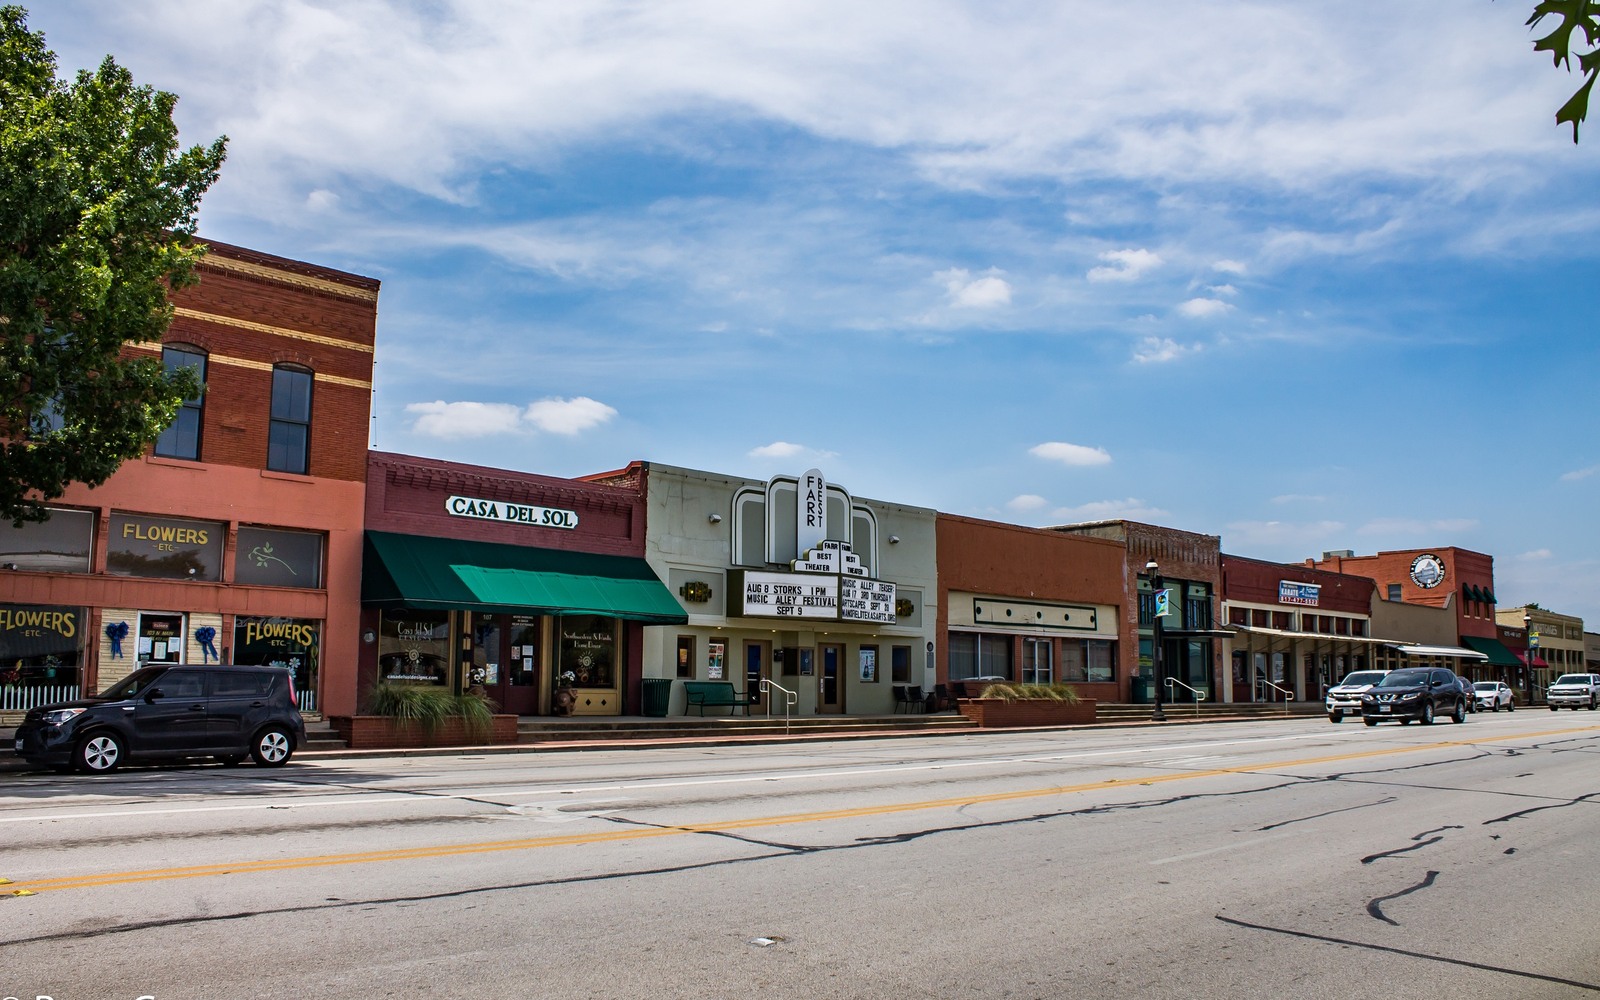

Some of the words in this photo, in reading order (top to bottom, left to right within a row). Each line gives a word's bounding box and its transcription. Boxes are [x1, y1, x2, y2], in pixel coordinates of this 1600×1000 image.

[806, 476, 815, 527] FARR
[452, 498, 499, 518] CASA
[506, 504, 537, 523] DEL
[542, 509, 573, 527] SOL
[123, 523, 209, 545] FLOWERS
[824, 542, 838, 550] FARR
[845, 555, 856, 563] BEST
[804, 563, 830, 571] THEATER
[847, 566, 863, 575] THEATER
[747, 583, 762, 593] AUG
[764, 584, 769, 593] 8
[773, 585, 802, 595] STORKS
[842, 579, 856, 588] MUSIC
[860, 581, 874, 590] ALLEY
[747, 594, 768, 604] MUSIC
[775, 595, 797, 605] ALLEY
[803, 596, 836, 607] FESTIVAL
[870, 592, 891, 602] THURSDAY
[776, 606, 794, 615] SEPT
[797, 607, 803, 615] 9
[842, 599, 866, 609] ARTSCAPES
[870, 601, 880, 611] SEPT
[246, 622, 313, 647] FLOWERS
